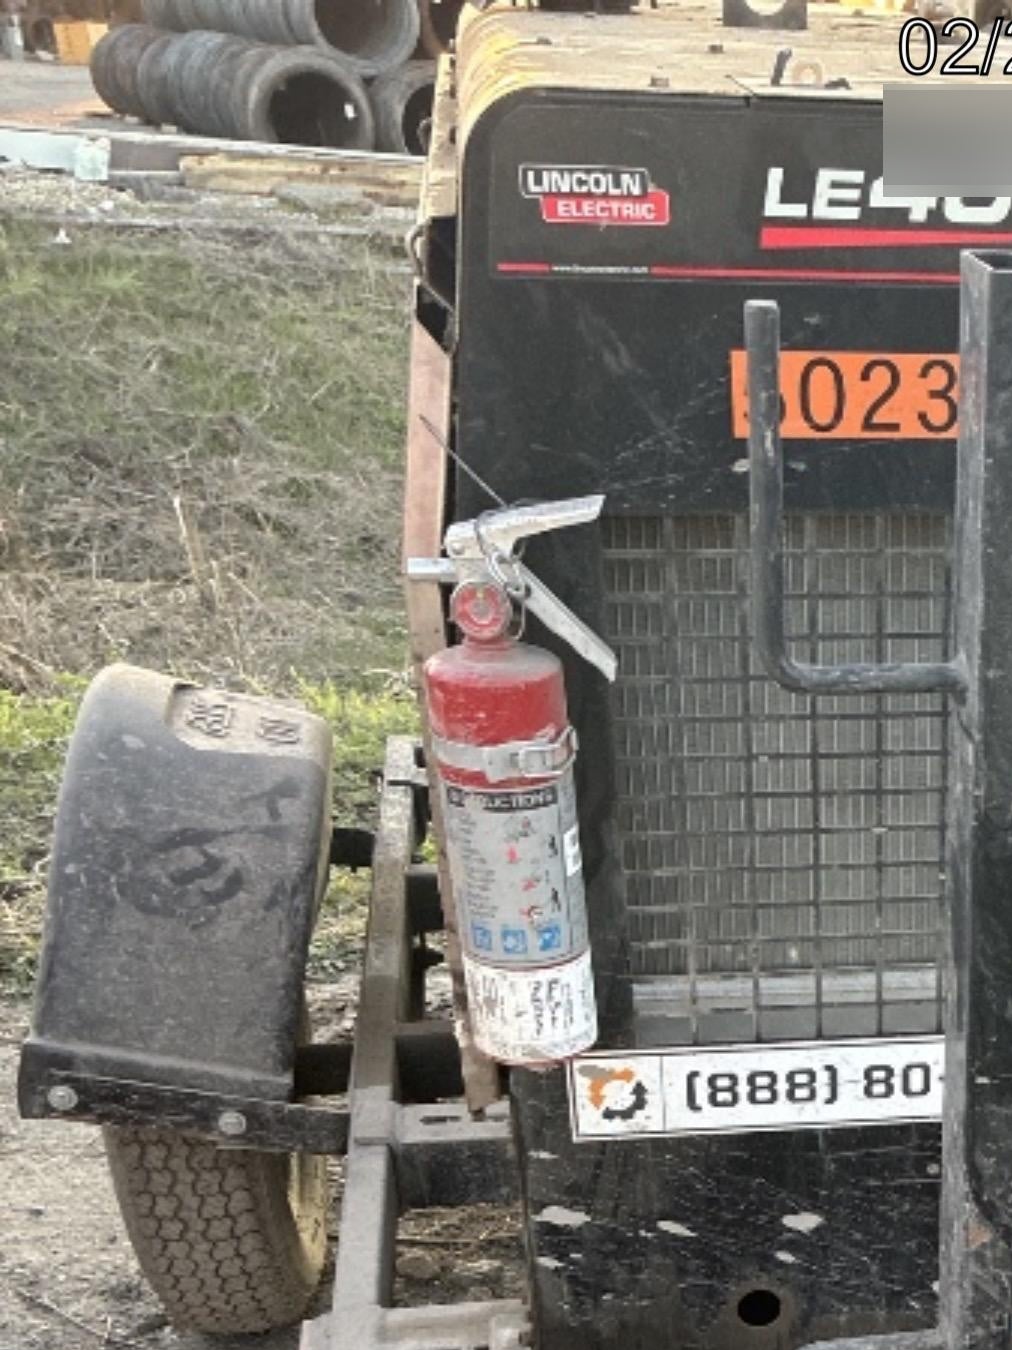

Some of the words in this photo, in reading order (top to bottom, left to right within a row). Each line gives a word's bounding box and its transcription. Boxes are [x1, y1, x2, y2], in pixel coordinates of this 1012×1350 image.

[526, 169, 642, 196] LINCOLN
[556, 200, 657, 220] ELECTRIC
[685, 1066, 839, 1109] (888)
